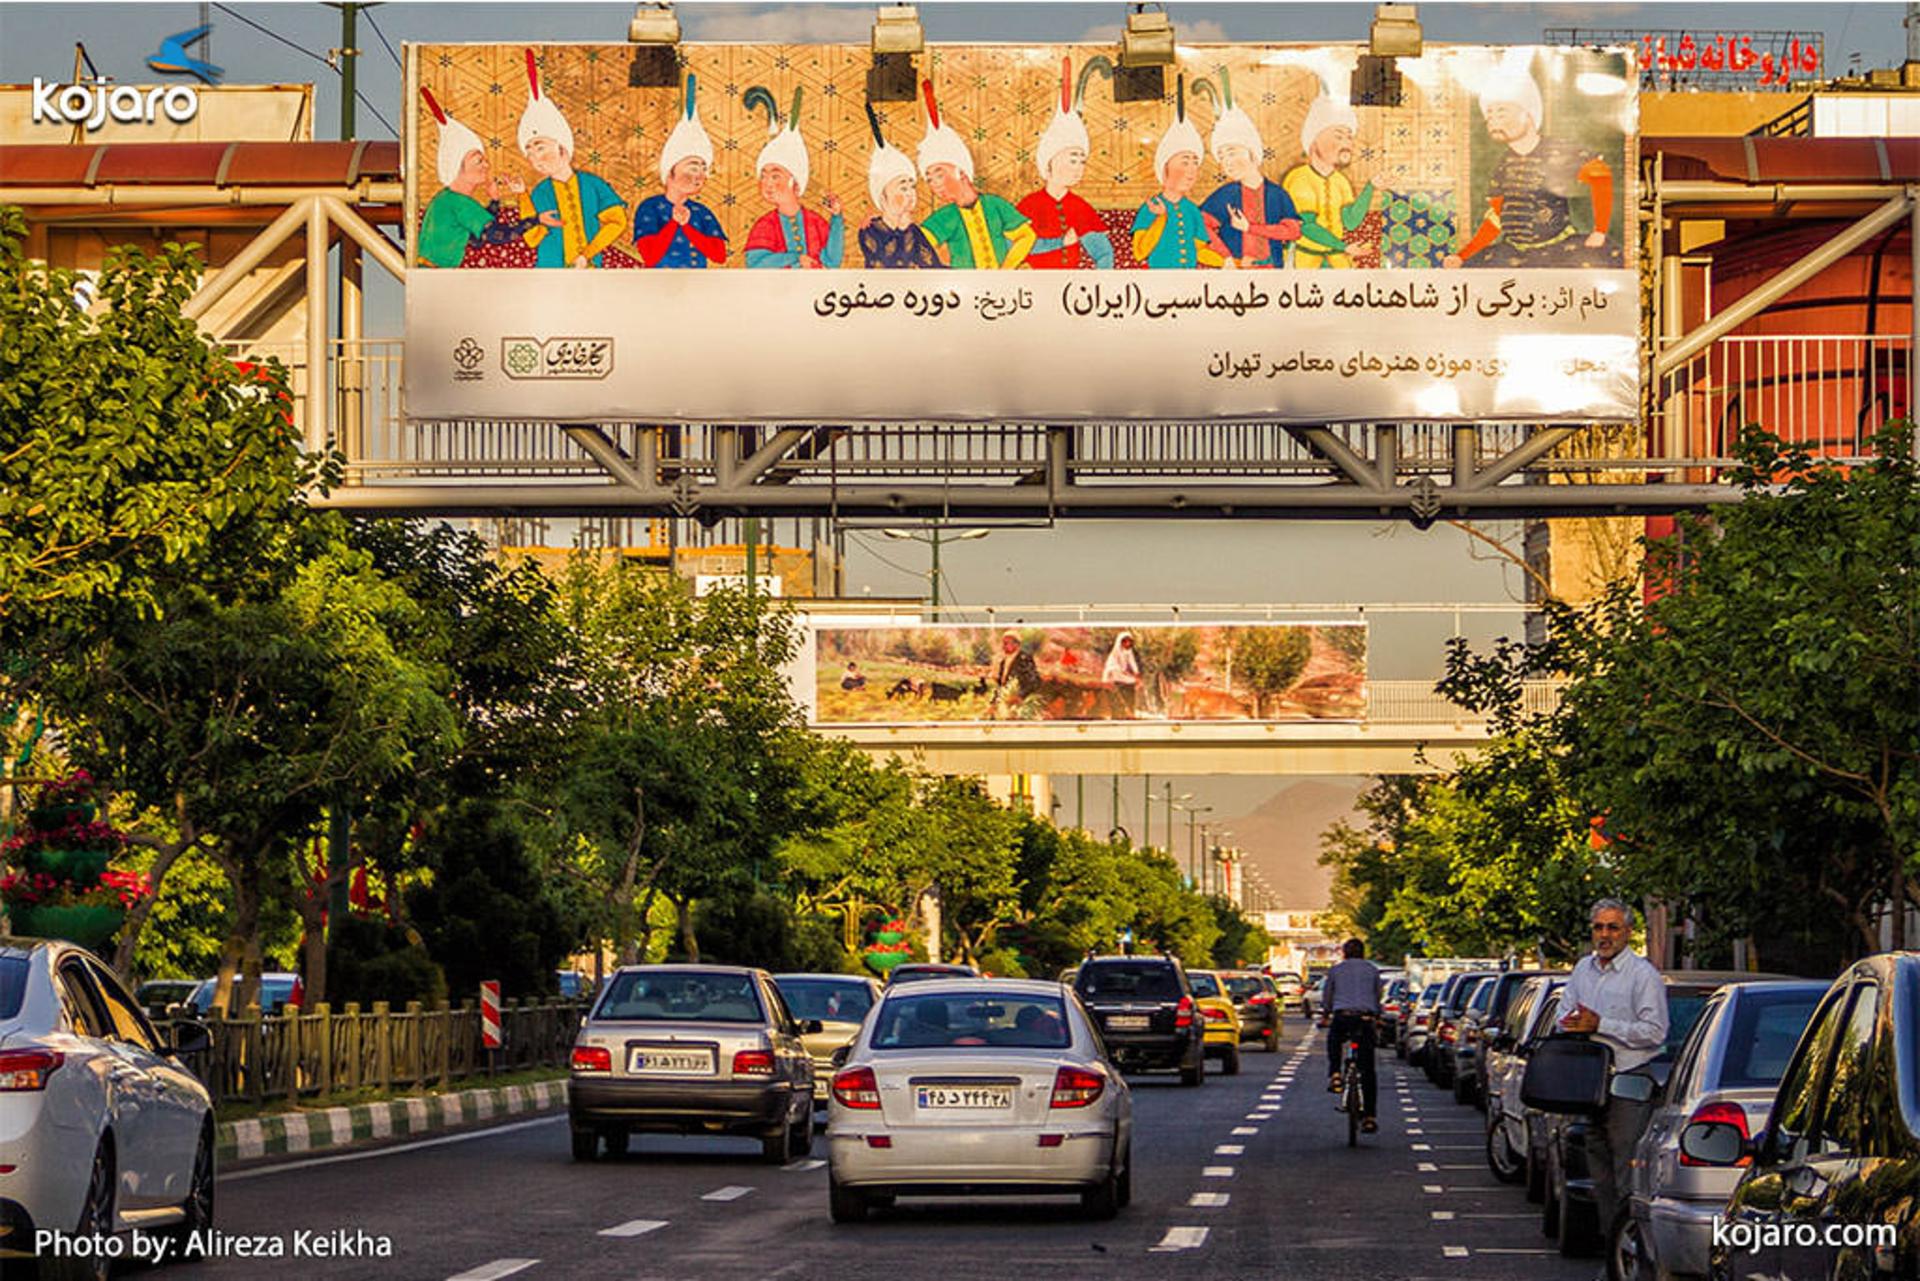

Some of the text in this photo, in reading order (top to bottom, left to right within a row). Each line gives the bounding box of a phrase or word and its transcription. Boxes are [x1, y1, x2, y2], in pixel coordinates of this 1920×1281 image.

[1700, 34, 1818, 86] داروخانه
[813, 282, 895, 318] صفوی
[903, 289, 961, 316] دوره
[974, 288, 1033, 320] تاریخ:
[1278, 282, 1324, 309] شاه
[1332, 282, 1439, 309] شاهنامه
[1446, 283, 1468, 315] از
[1476, 279, 1535, 318] برگی
[1541, 287, 1574, 315] اثر:
[1579, 287, 1608, 320] نام
[1207, 350, 1262, 379] تهران
[1266, 350, 1335, 378] معاصر
[1339, 351, 1420, 378] هنرهای
[1424, 353, 1472, 378] موزه
